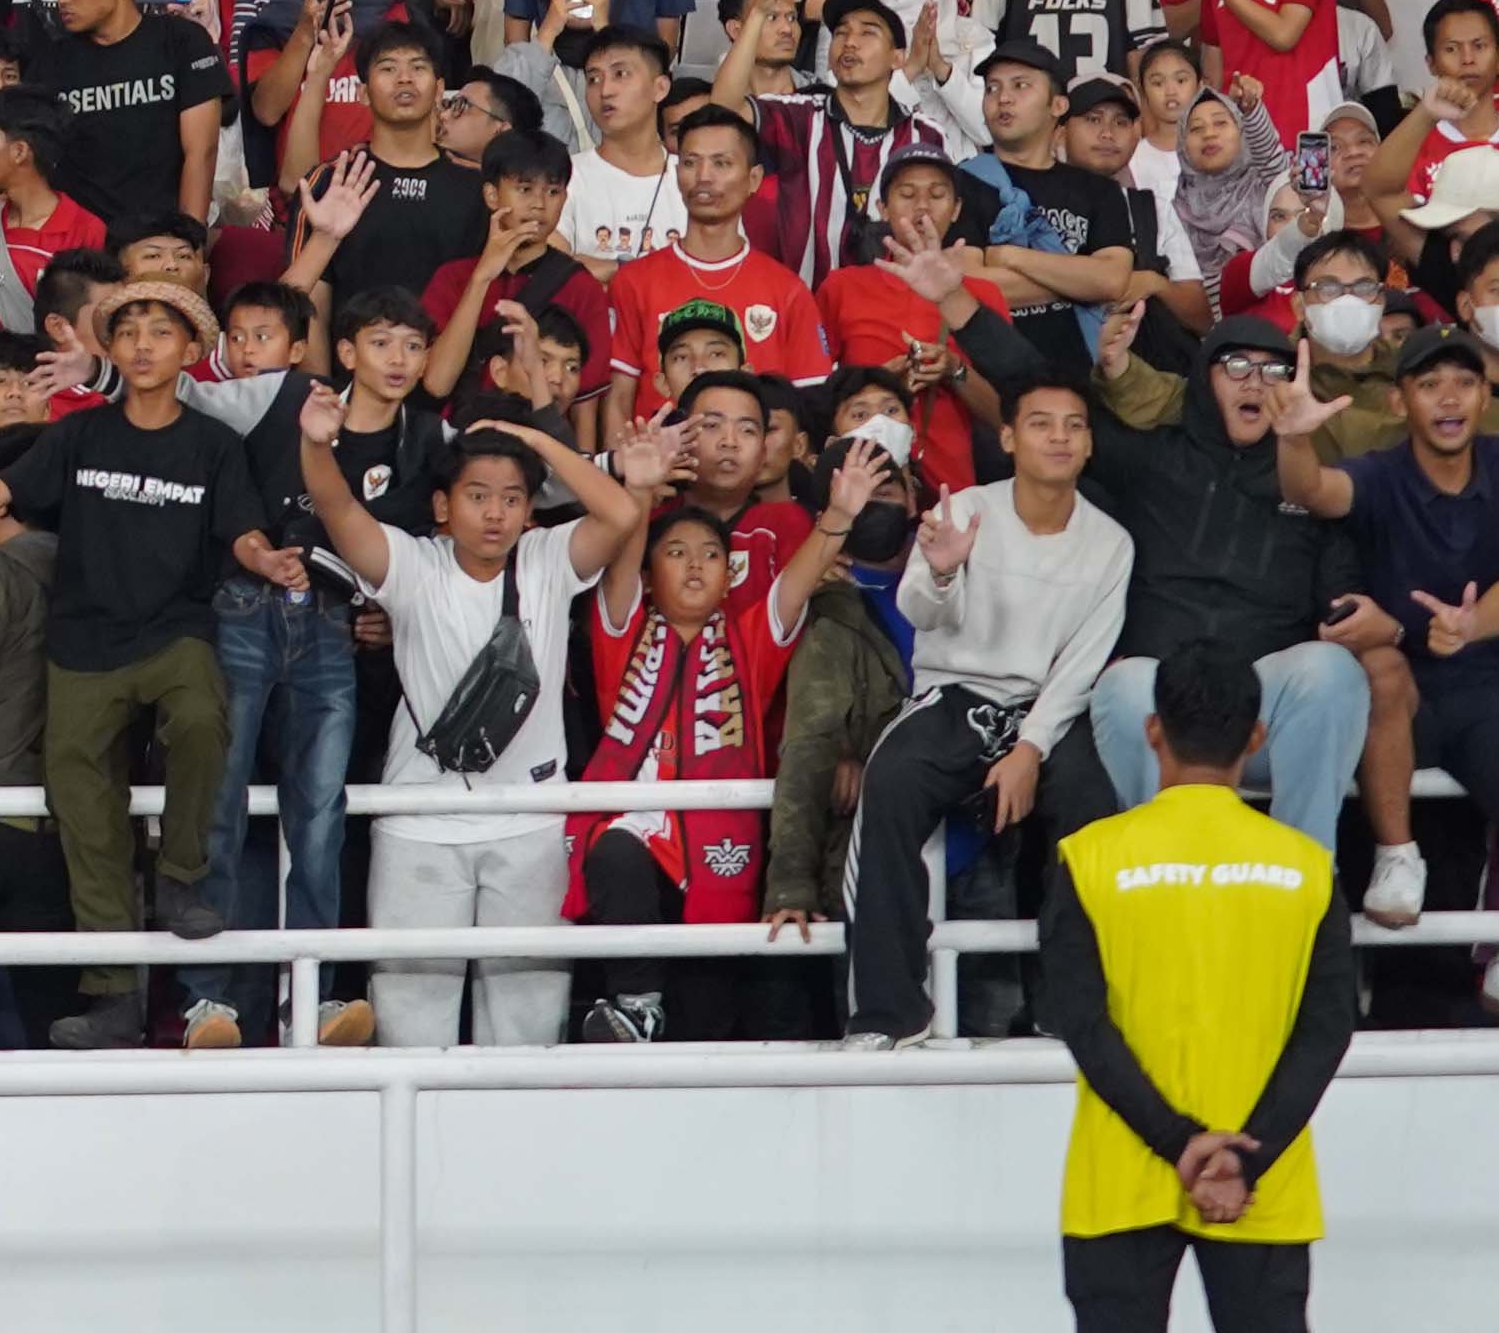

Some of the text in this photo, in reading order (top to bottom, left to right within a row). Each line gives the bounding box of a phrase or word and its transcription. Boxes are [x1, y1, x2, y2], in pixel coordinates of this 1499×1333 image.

[75, 468, 140, 494] NEGERI
[142, 476, 206, 505] EMPAT
[1115, 862, 1304, 891] SAFETY GUARD
